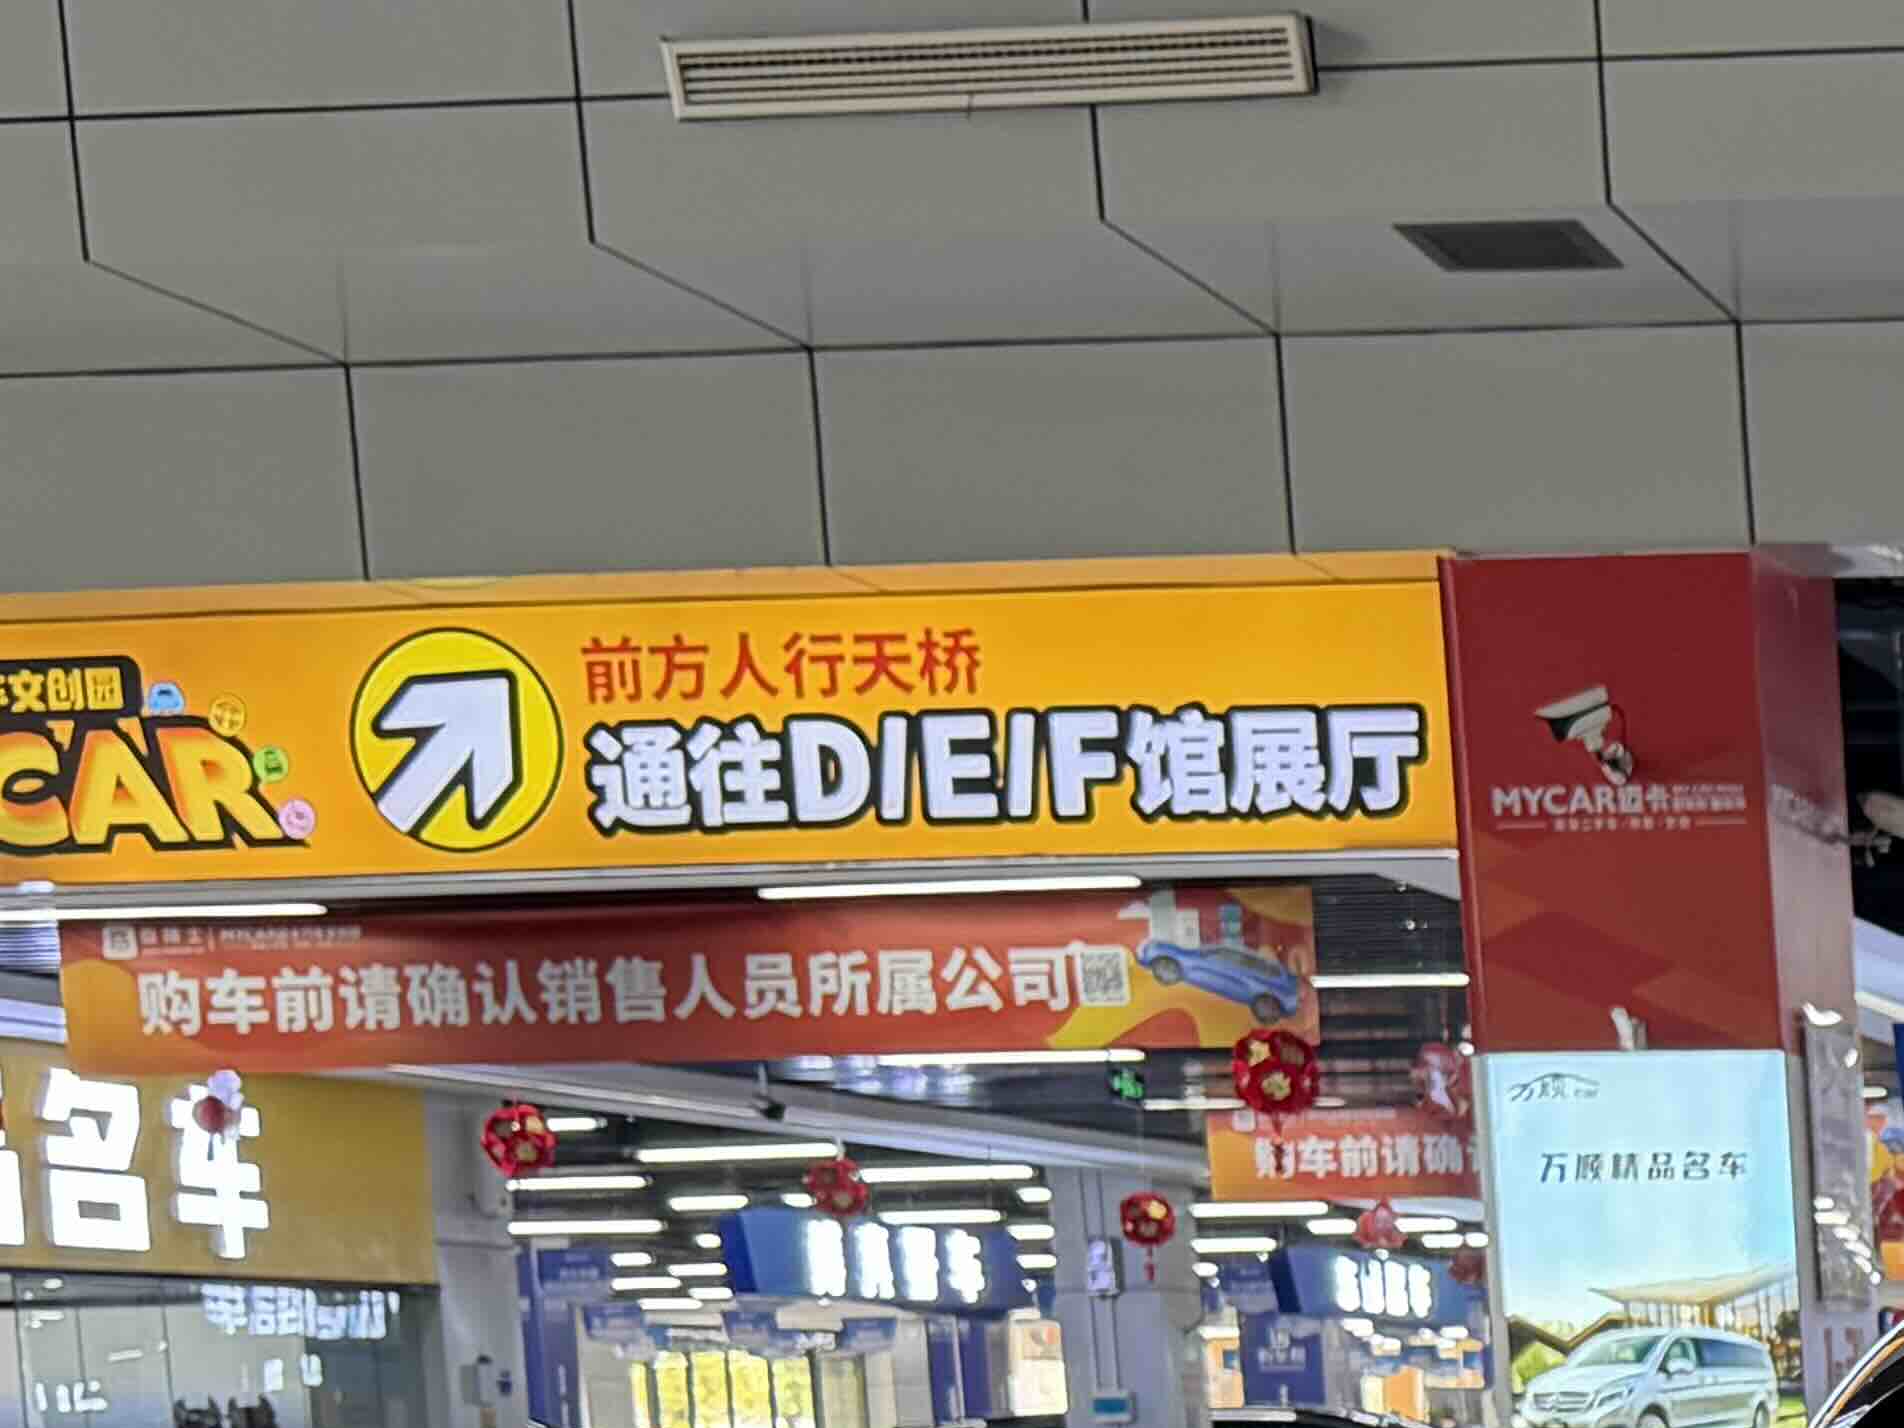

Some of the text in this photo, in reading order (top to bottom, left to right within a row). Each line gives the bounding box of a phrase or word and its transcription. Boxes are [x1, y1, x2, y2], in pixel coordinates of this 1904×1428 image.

[0, 667, 124, 714] 文创园
[580, 627, 983, 704] 前方人行天桥
[137, 943, 1078, 1038] 购车前请确认销售人员所属公司
[0, 1066, 270, 1259] 名车
[1540, 1150, 1748, 1184] 万顺精品名车
